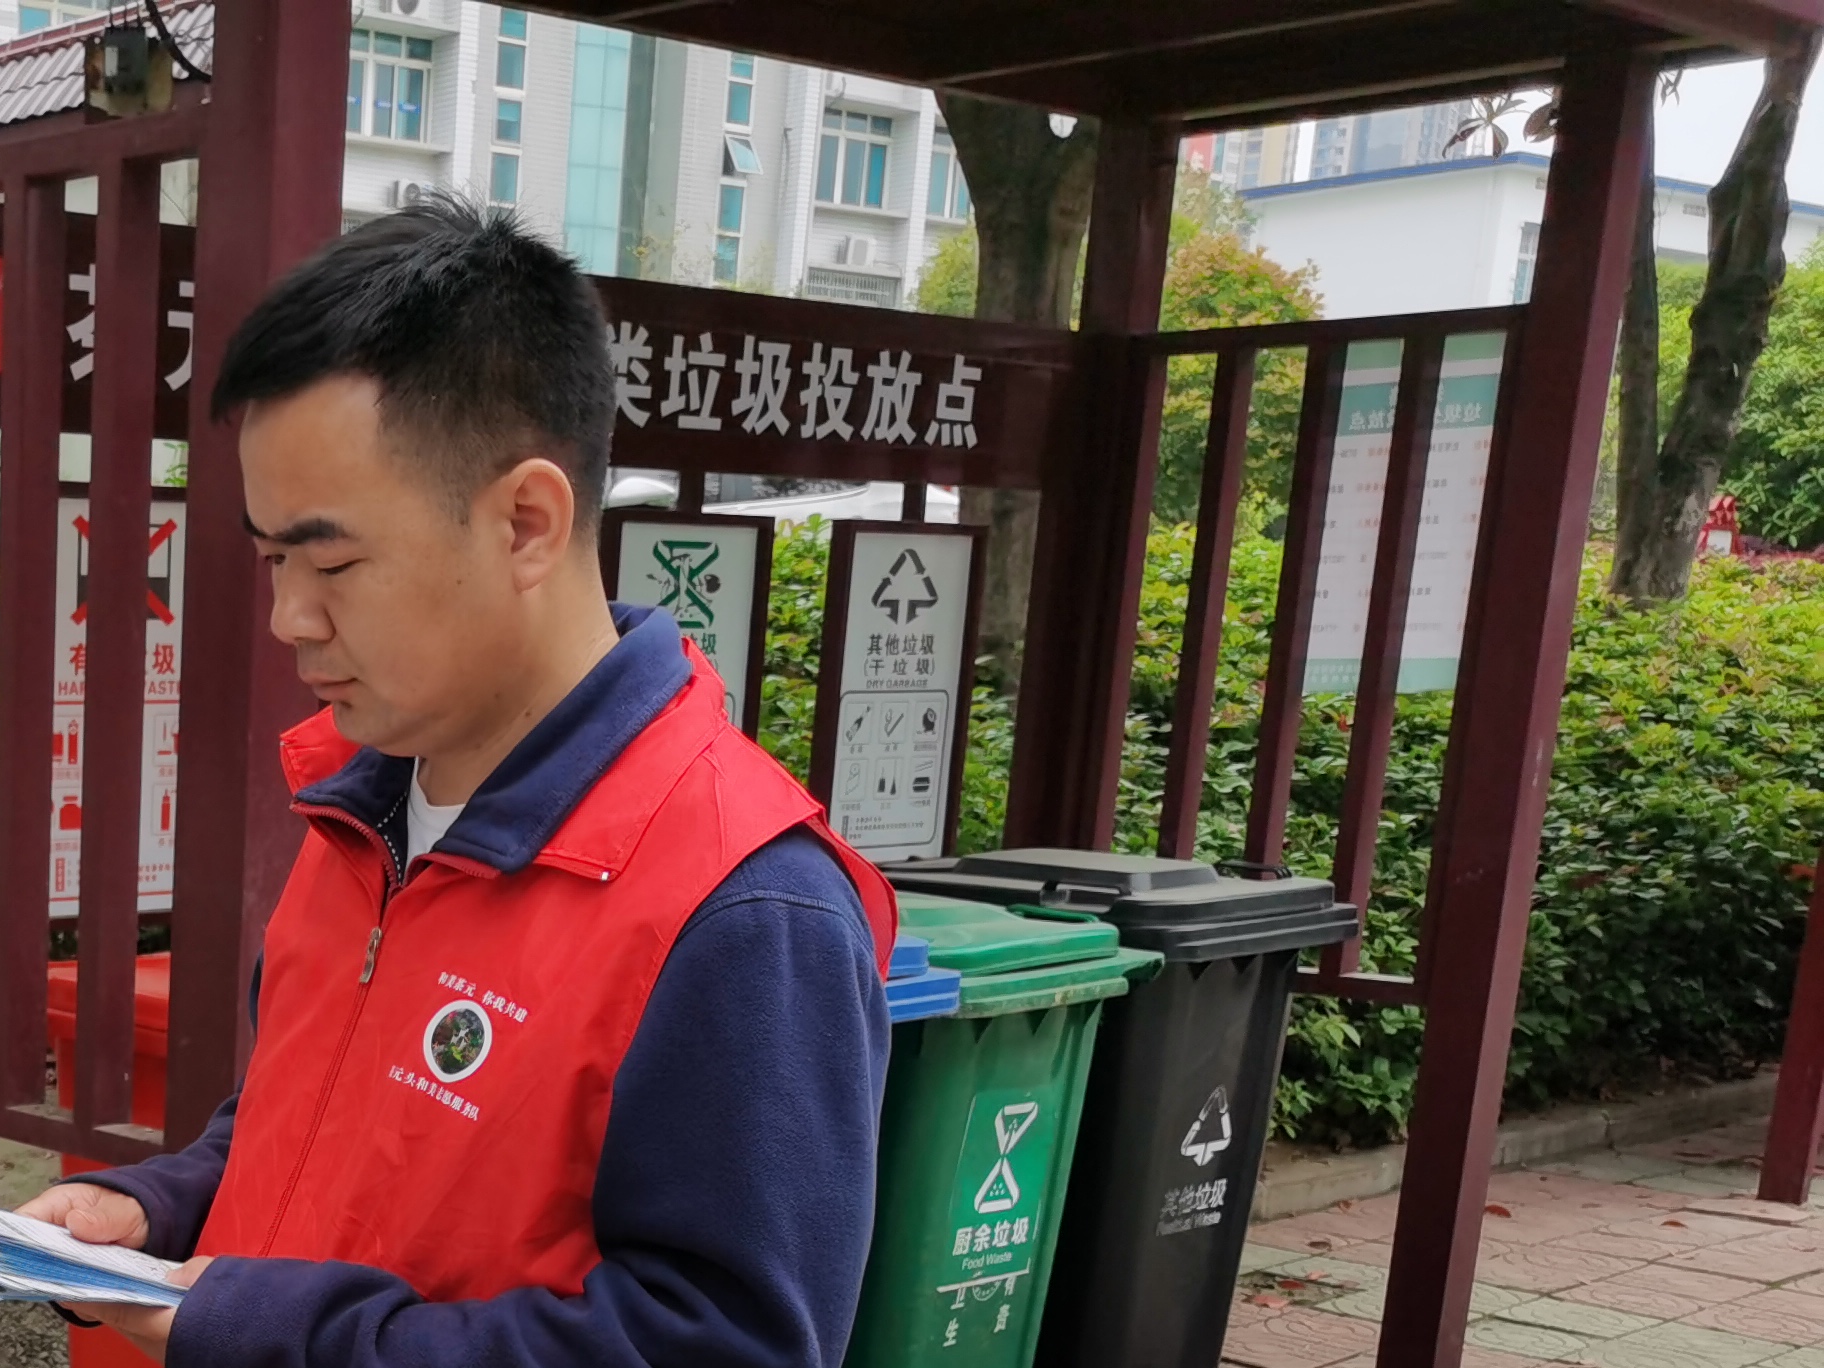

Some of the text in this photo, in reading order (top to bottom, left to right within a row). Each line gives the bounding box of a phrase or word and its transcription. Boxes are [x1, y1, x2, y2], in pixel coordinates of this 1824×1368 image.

[867, 633, 935, 656] 其他垃圾
[952, 1216, 1029, 1256] 厨余垃圾
[962, 1251, 1013, 1271] Food Waste
